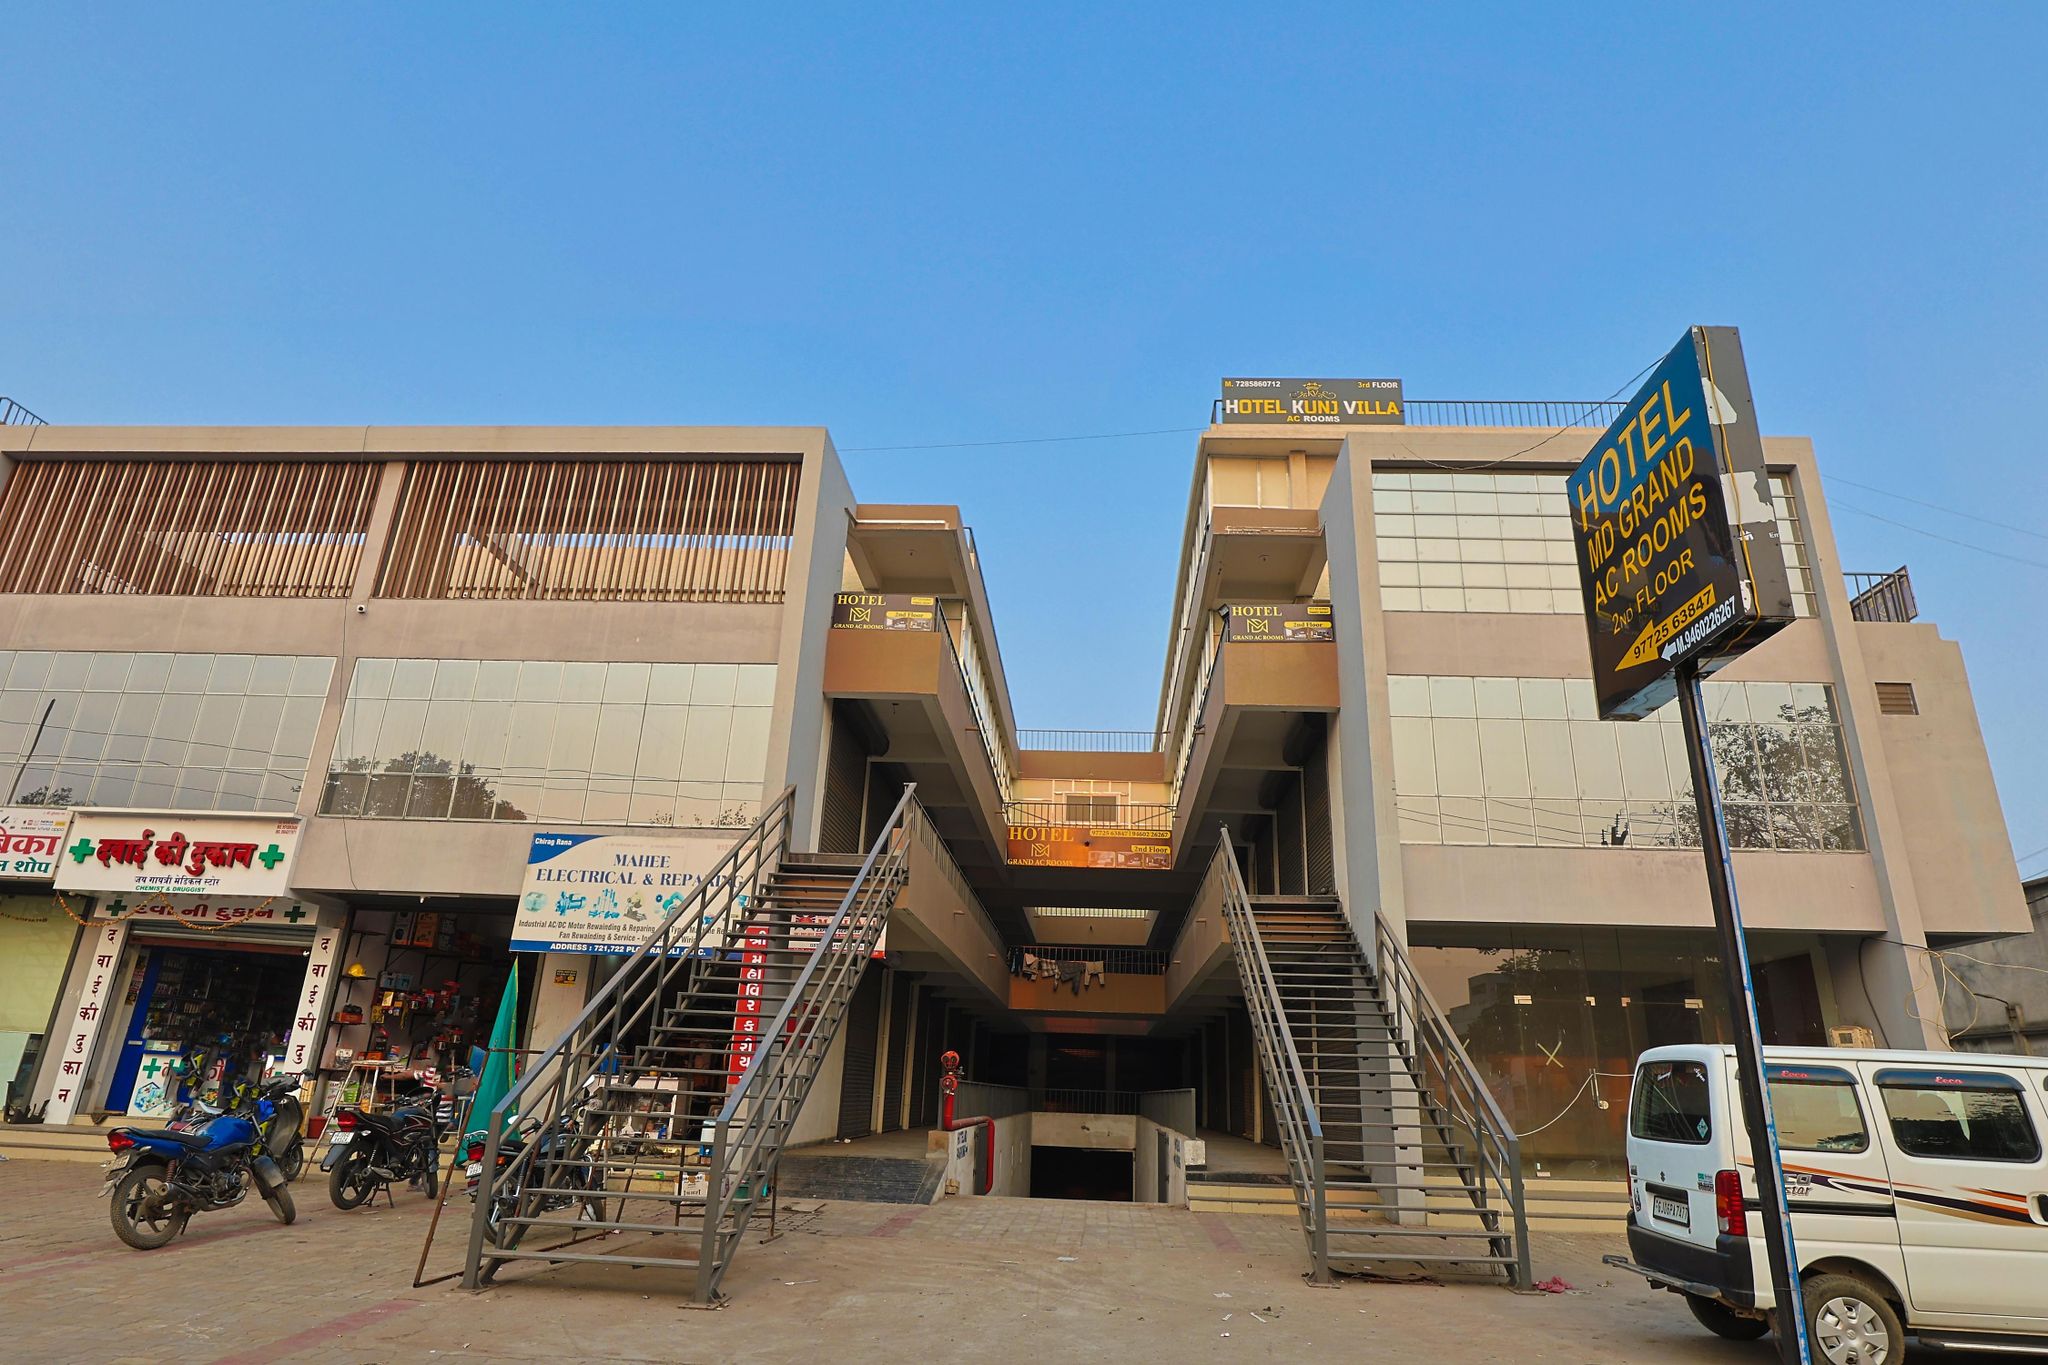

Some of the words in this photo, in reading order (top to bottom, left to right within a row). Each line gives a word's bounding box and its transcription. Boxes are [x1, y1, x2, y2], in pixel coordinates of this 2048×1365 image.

[1225, 399, 1287, 414] HOTEL
[1292, 399, 1339, 415] KUNJ
[1343, 400, 1400, 415] VILLA
[1303, 415, 1340, 423] ROOMS
[1577, 379, 1692, 533] HOTEL
[1587, 519, 1615, 573] MD
[1618, 436, 1694, 539] GRAND
[1595, 565, 1619, 613] AC
[1622, 481, 1707, 583] ROOMS
[837, 594, 887, 606] HOTEL
[1612, 607, 1634, 636] 2ND
[1636, 548, 1695, 614] FLOOR
[1232, 606, 1283, 617] HOTEL
[1633, 626, 1669, 659] 97725
[1671, 589, 1712, 629] 63847
[1675, 595, 1736, 656] M.9460226267
[535, 837, 555, 847] Chirag
[556, 838, 573, 846] Rana
[1008, 826, 1074, 842] HOTEL
[97, 828, 155, 870] दवाई
[154, 831, 189, 867] की
[184, 841, 259, 877] दुकान
[14, 857, 52, 874] शोप
[613, 854, 671, 869] MAHEE
[1046, 859, 1073, 867] ROOMS
[536, 868, 637, 885] ELECTRICAL
[643, 873, 654, 886] &
[519, 919, 547, 928] Industrial
[548, 921, 567, 929] AC/DC
[568, 921, 586, 930] Motor
[587, 923, 621, 933] Rewainding
[628, 924, 656, 933] Reparing
[559, 931, 571, 939] Fan
[571, 932, 606, 941] Rewainding
[550, 943, 588, 951] ADDRESS
[594, 944, 625, 953] 721,722
